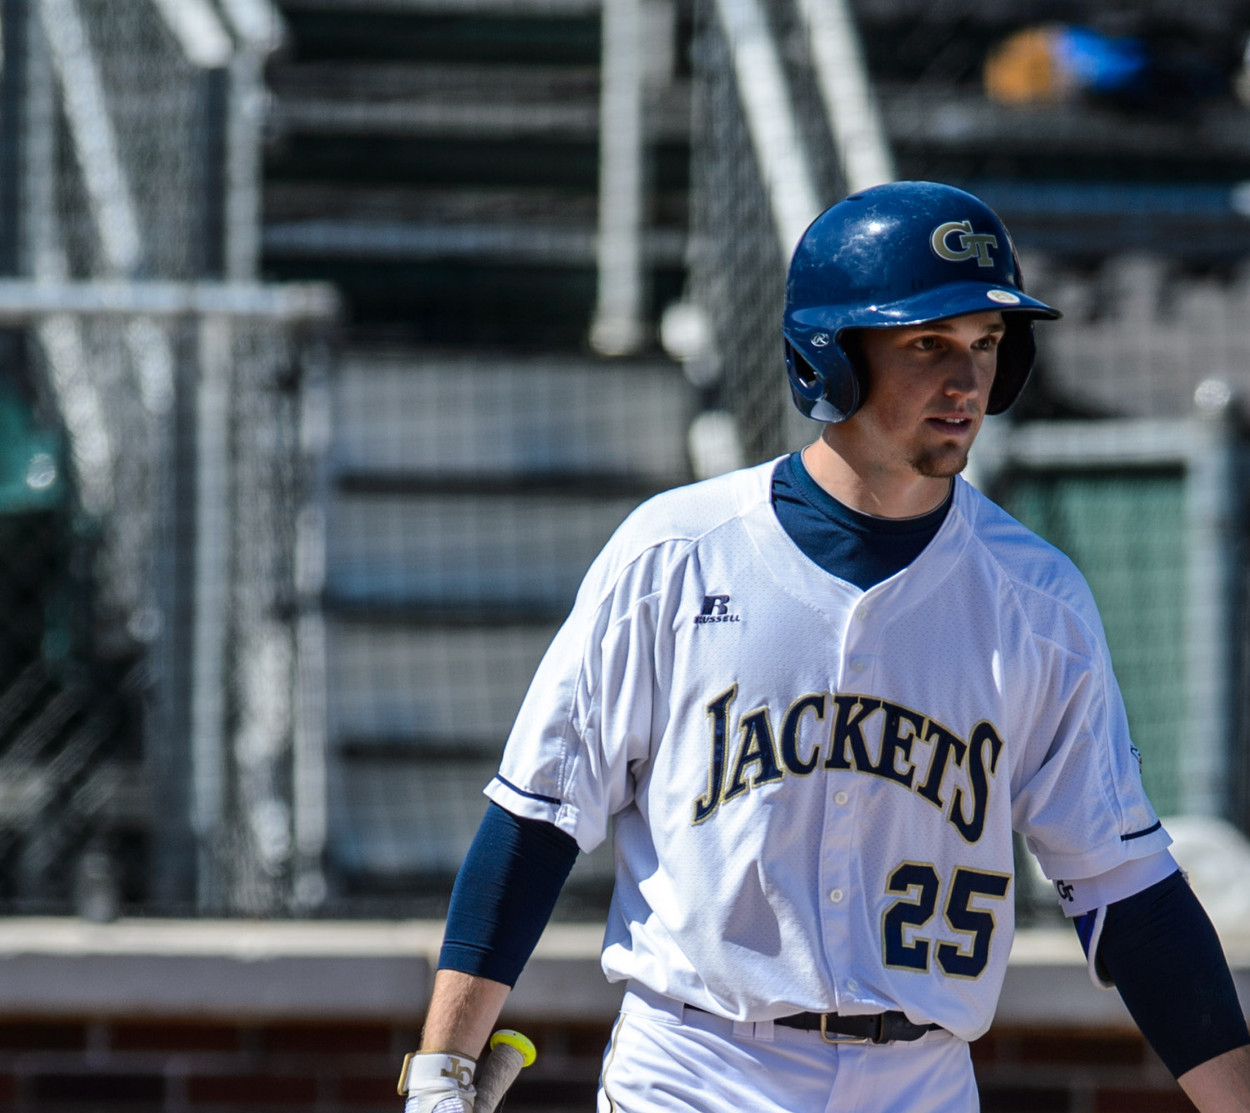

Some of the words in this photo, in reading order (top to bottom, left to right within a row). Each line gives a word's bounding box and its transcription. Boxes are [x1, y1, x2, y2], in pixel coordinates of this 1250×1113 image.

[931, 220, 998, 268] GT
[694, 614, 741, 624] RUSSELL
[691, 682, 1004, 845] JACKETS
[881, 860, 1013, 981] 25
